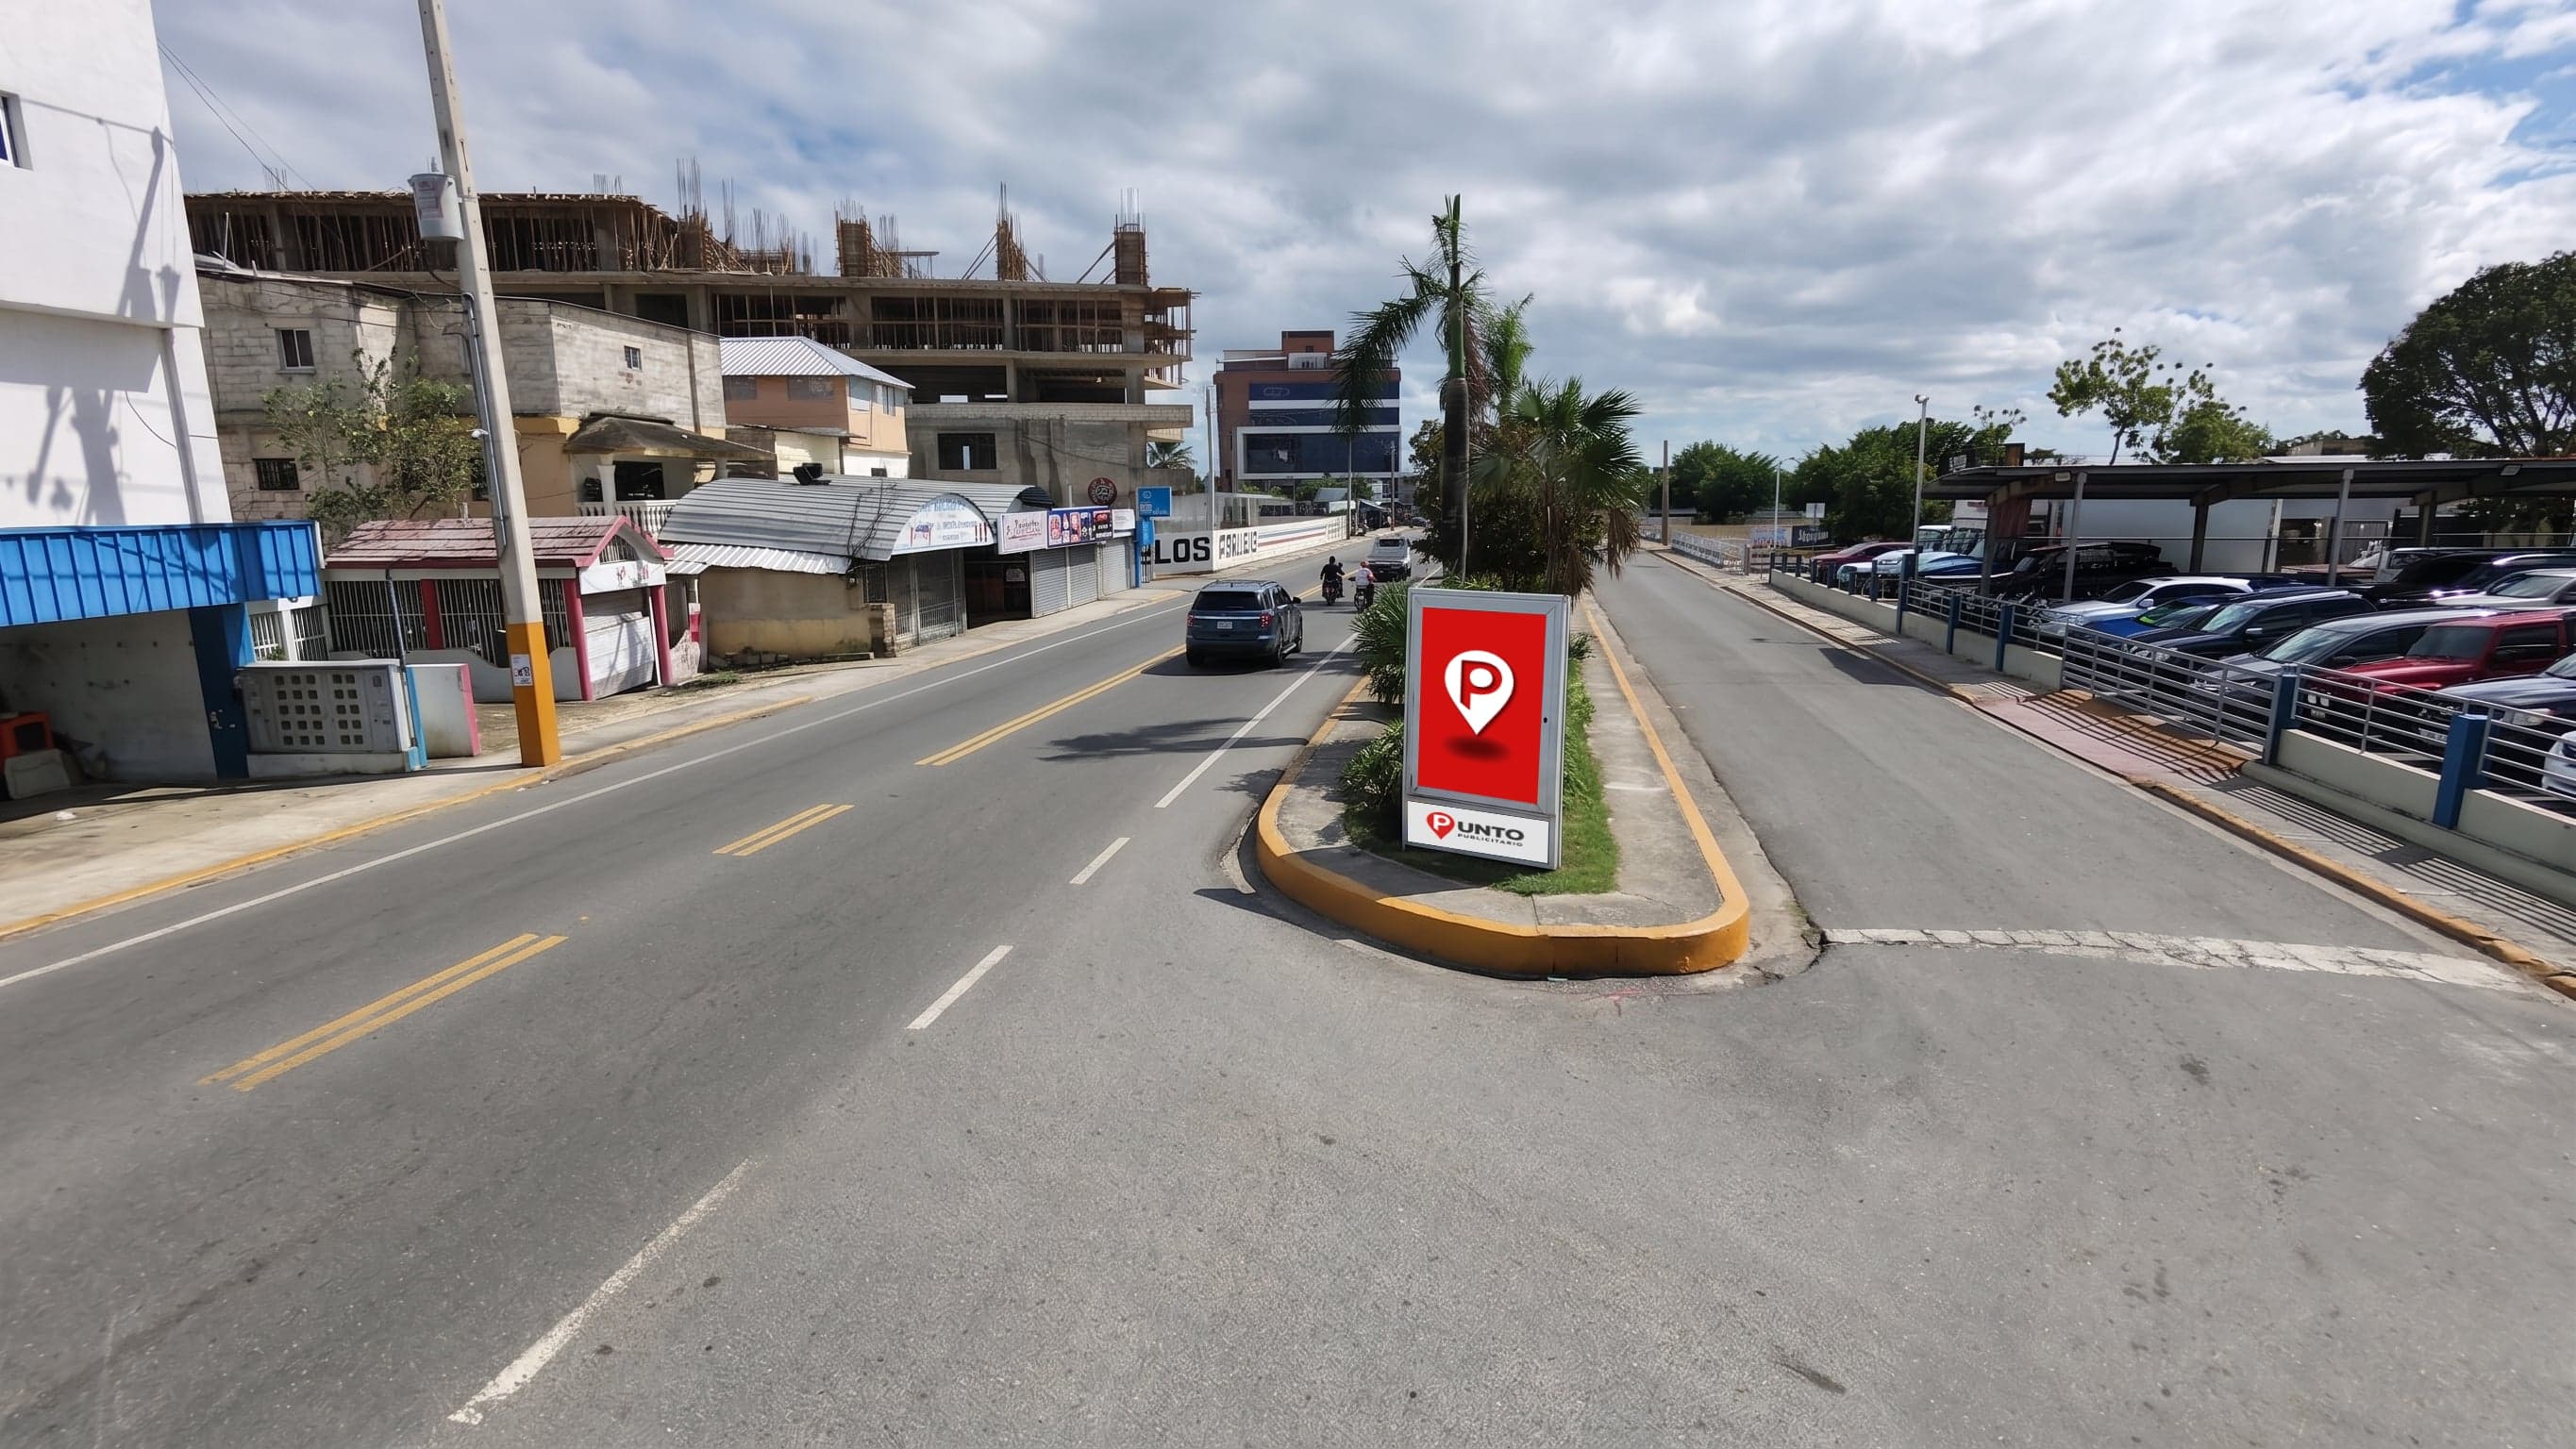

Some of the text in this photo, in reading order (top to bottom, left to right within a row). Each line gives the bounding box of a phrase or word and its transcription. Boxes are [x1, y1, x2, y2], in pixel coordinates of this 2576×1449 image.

[1154, 537, 1211, 564] LOS
[1460, 659, 1503, 710] P
[1430, 812, 1525, 841] PUNTO
[1457, 833, 1524, 847] PUBLICITARIO
